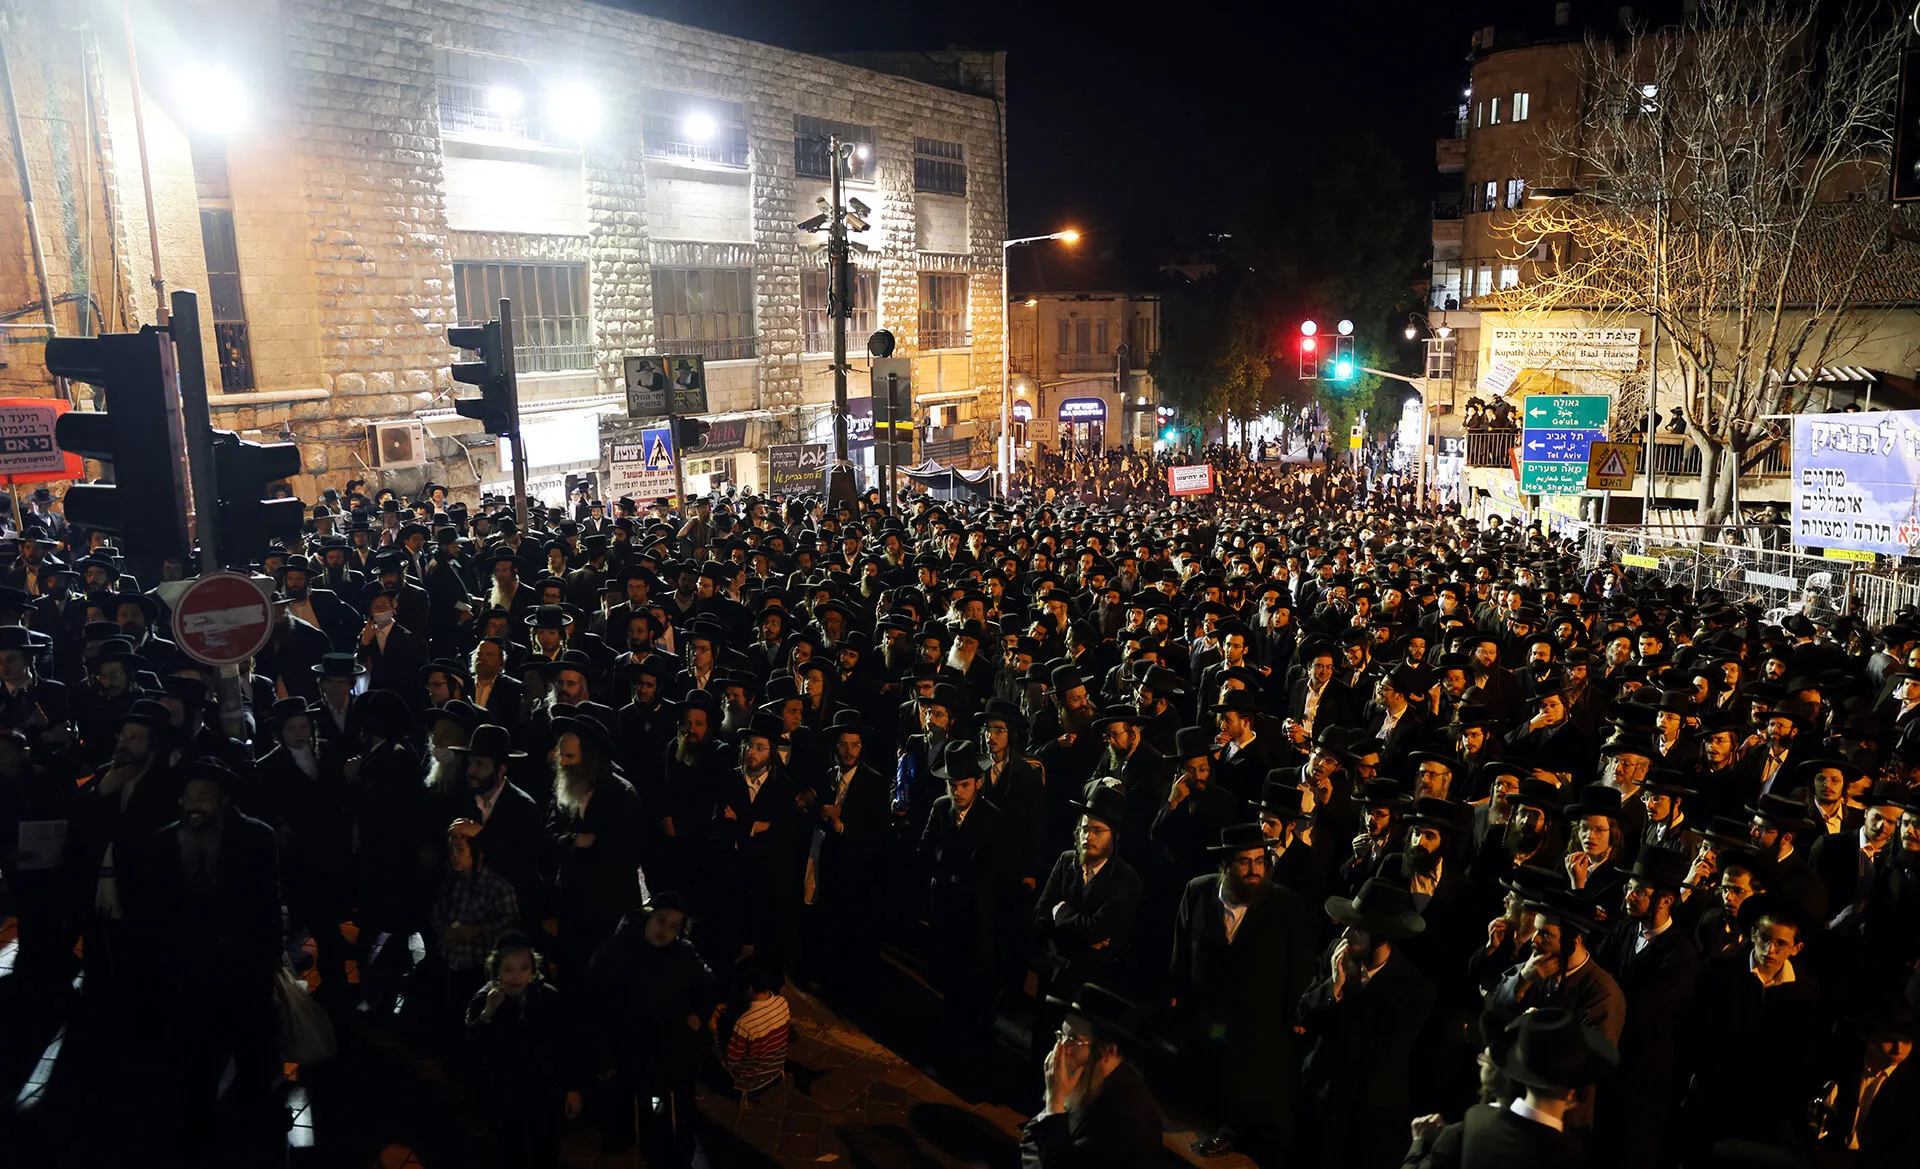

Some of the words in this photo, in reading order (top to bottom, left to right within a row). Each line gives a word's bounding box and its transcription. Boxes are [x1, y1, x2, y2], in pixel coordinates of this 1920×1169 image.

[1496, 331, 1516, 339] הנס
[1549, 331, 1577, 339] מאיר
[1603, 350, 1634, 358] Haness
[631, 393, 650, 402] המלך
[1553, 399, 1579, 407] גאולה
[9, 413, 39, 423] היעד
[1570, 431, 1584, 440] תל
[5, 439, 30, 451] אם
[34, 438, 49, 449] כי
[798, 445, 825, 468] אבא
[1528, 465, 1557, 473] שערים
[1561, 465, 1582, 474] מאה
[1600, 478, 1621, 487] האט
[1803, 469, 1845, 487] מחיים
[1802, 488, 1863, 514] אומללים
[1801, 519, 1848, 538] ומצוות
[1854, 521, 1891, 542] תורה
